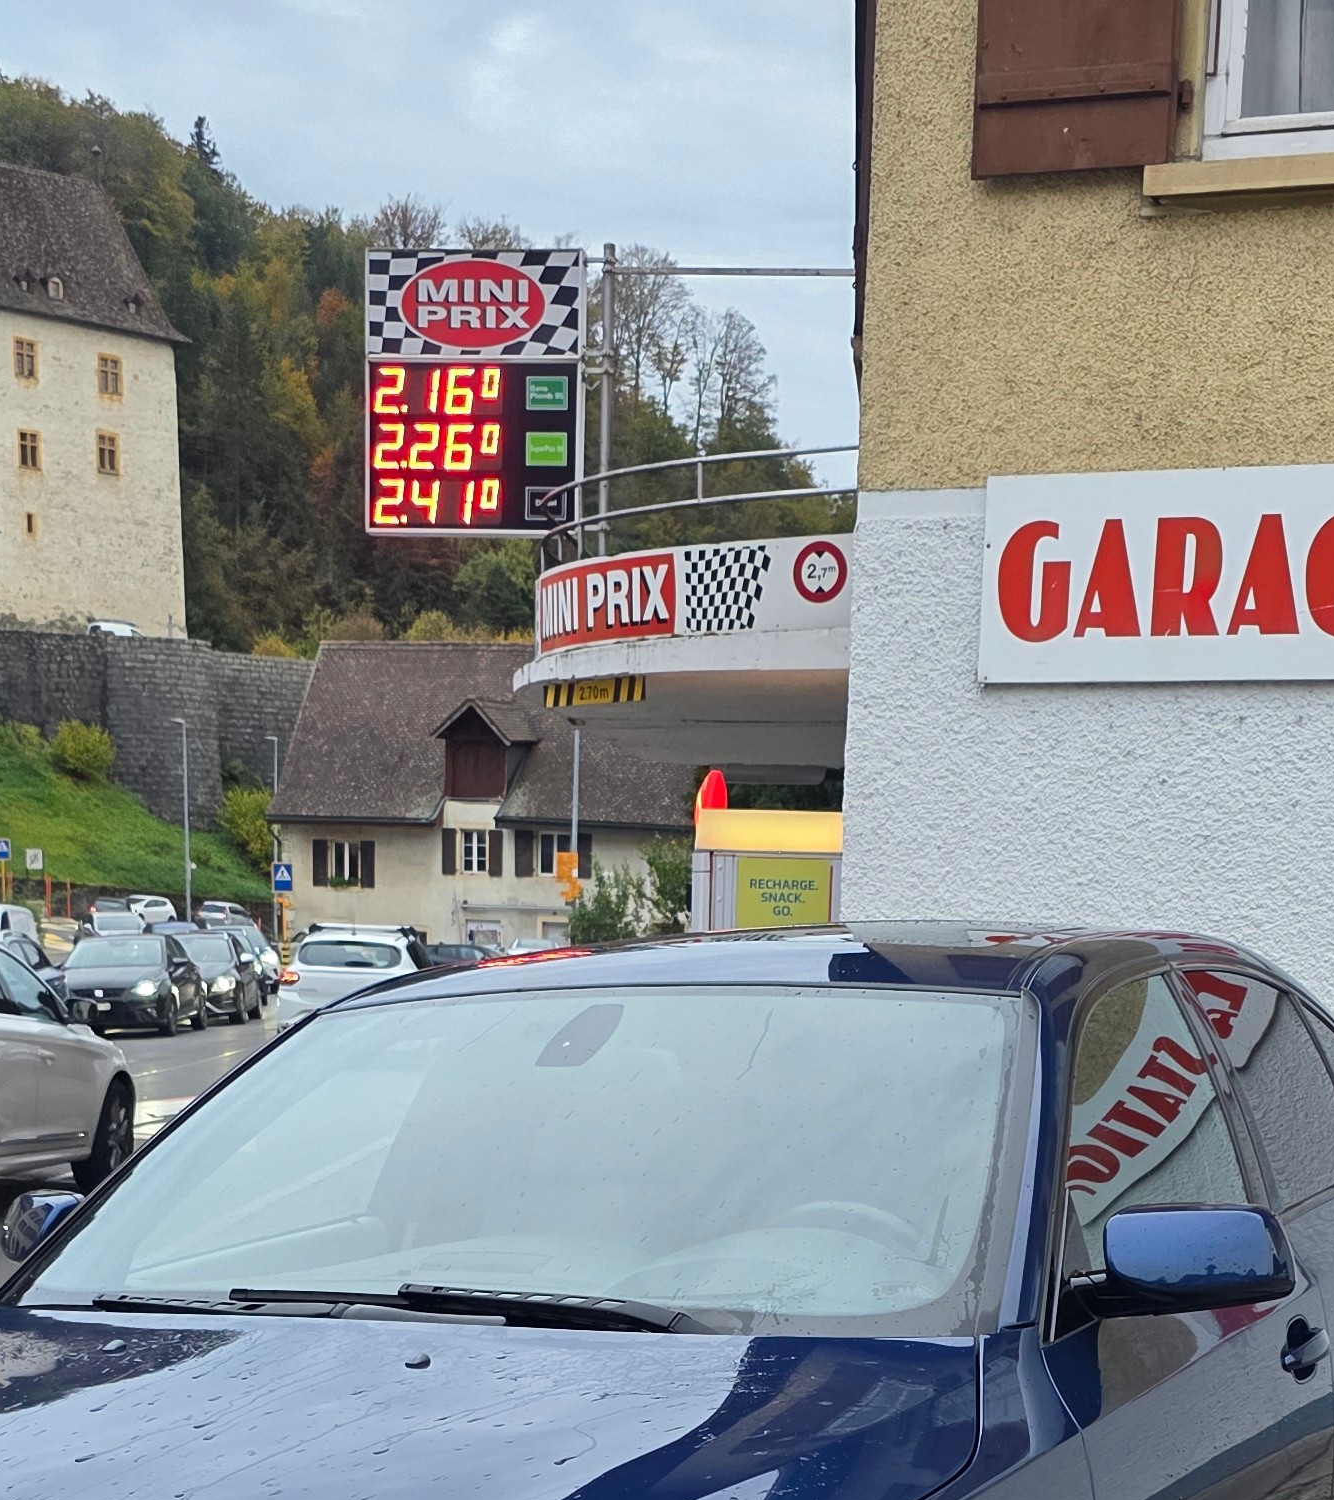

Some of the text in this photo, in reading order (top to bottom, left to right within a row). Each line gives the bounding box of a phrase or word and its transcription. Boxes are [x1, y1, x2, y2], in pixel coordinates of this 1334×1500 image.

[418, 279, 529, 303] MINI
[418, 306, 530, 329] PRIX
[542, 564, 670, 639] MINI PRIX
[749, 878, 818, 891] RECHARGE.
[760, 892, 806, 903] SNACK.
[772, 905, 793, 917] GO.
